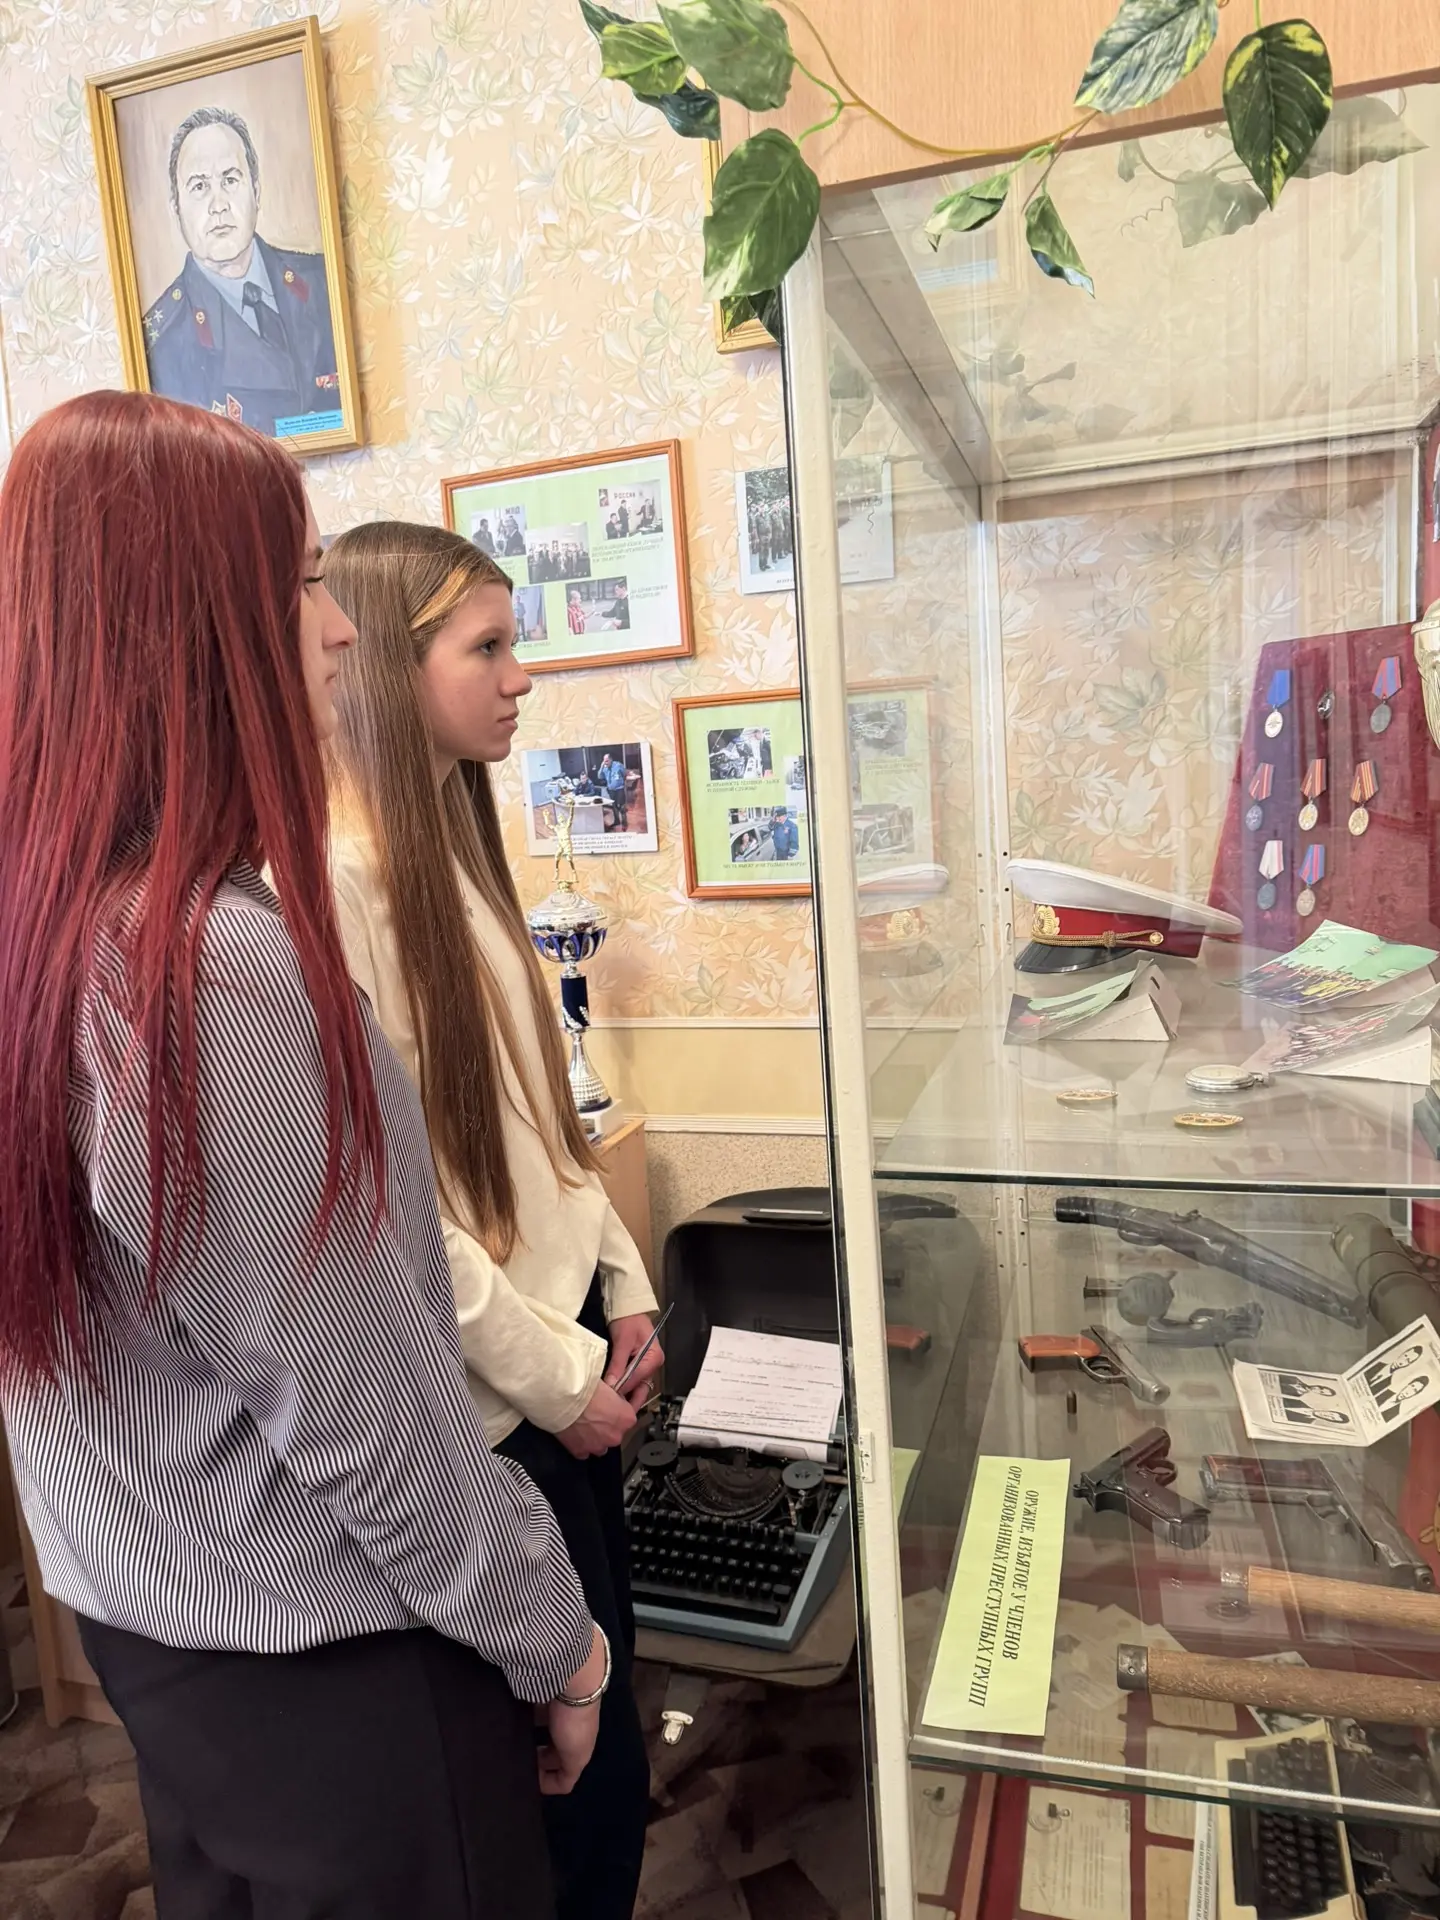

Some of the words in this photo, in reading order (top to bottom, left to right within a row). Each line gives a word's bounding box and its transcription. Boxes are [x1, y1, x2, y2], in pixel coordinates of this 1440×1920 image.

[994, 1465, 1023, 1564] ОРГАНИЗОВАННЫХ
[1019, 1490, 1040, 1534] ОРУЖИЕ,
[1012, 1535, 1034, 1591] ИЗЪЯТОЕ
[977, 1566, 1007, 1656] ПРЕСТУПНЫХ
[1011, 1592, 1027, 1604] У
[1002, 1605, 1025, 1661] ЧЛЕНОВ
[967, 1656, 993, 1708] ГРУПП
